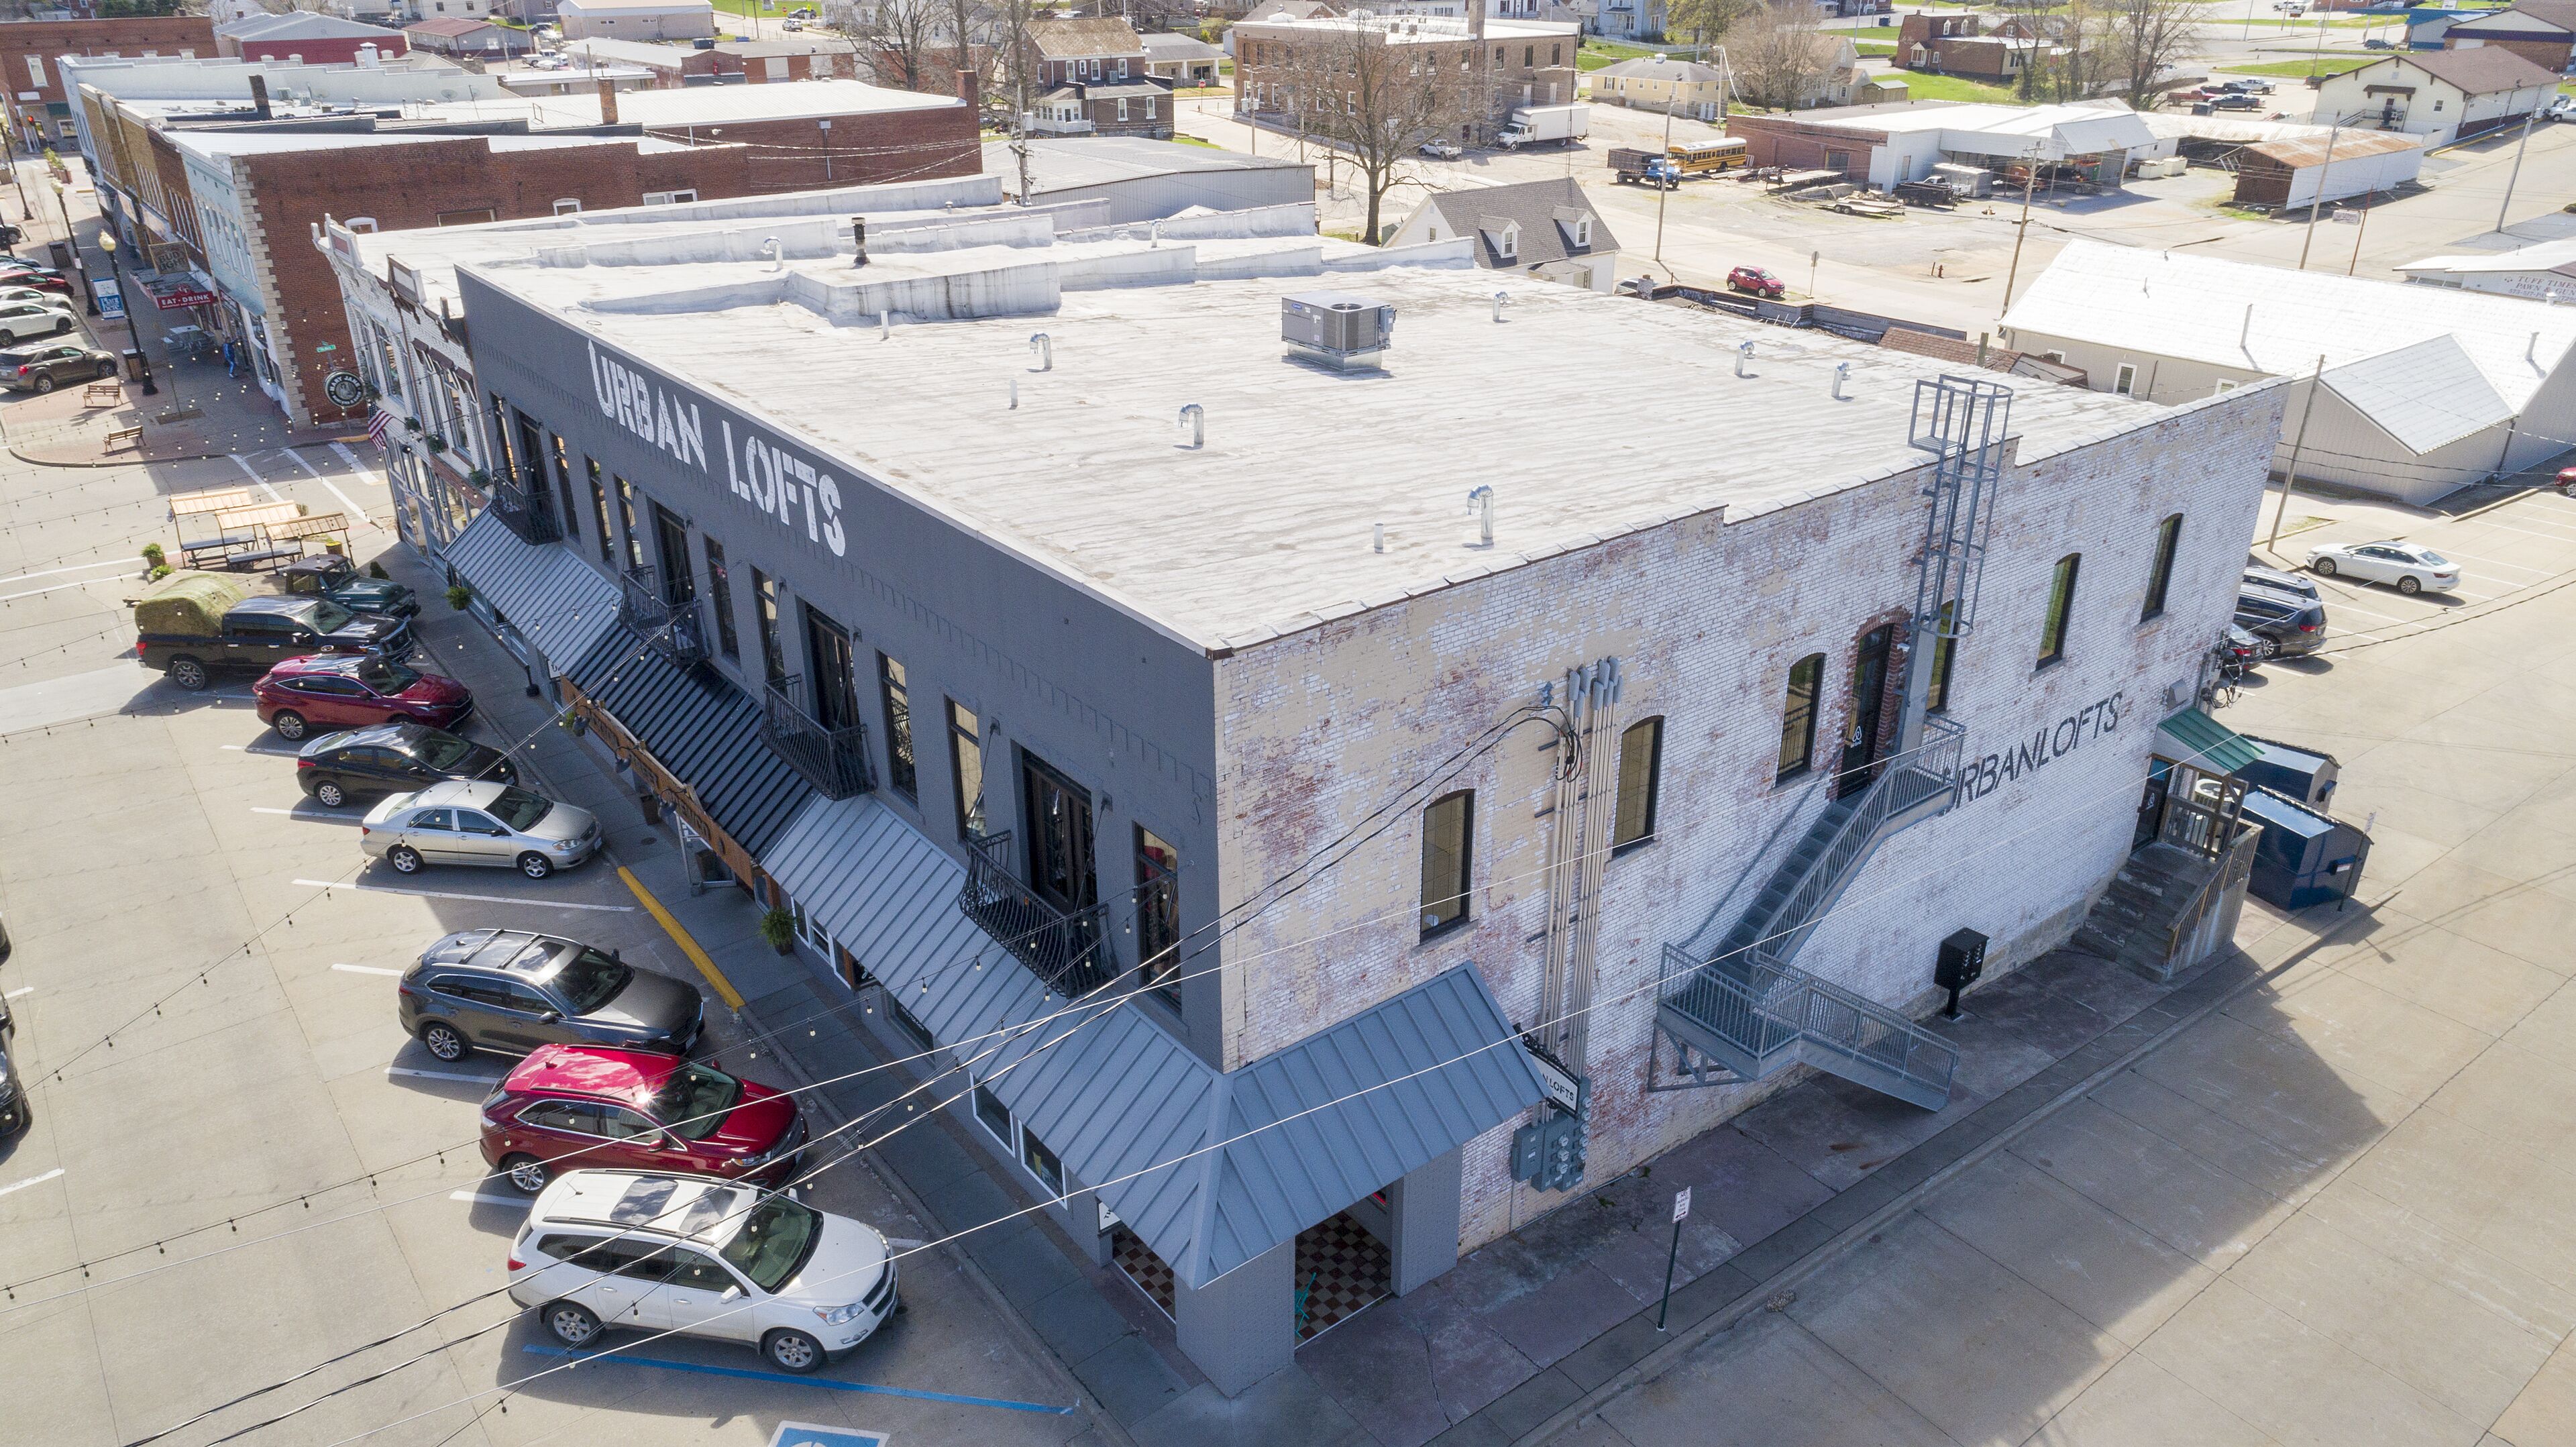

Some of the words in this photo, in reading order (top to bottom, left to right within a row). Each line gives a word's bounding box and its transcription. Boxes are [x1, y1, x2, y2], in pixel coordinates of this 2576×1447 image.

[2516, 282, 2541, 291] PAWN
[2518, 276, 2544, 284] TUFF
[161, 297, 177, 306] EAT
[182, 294, 210, 303] DRINK
[329, 376, 343, 392] MARY
[343, 376, 361, 388] JANE
[588, 338, 708, 474] URBAN
[722, 419, 846, 557] LOFTS
[1549, 1077, 1574, 1102] LOFTS
